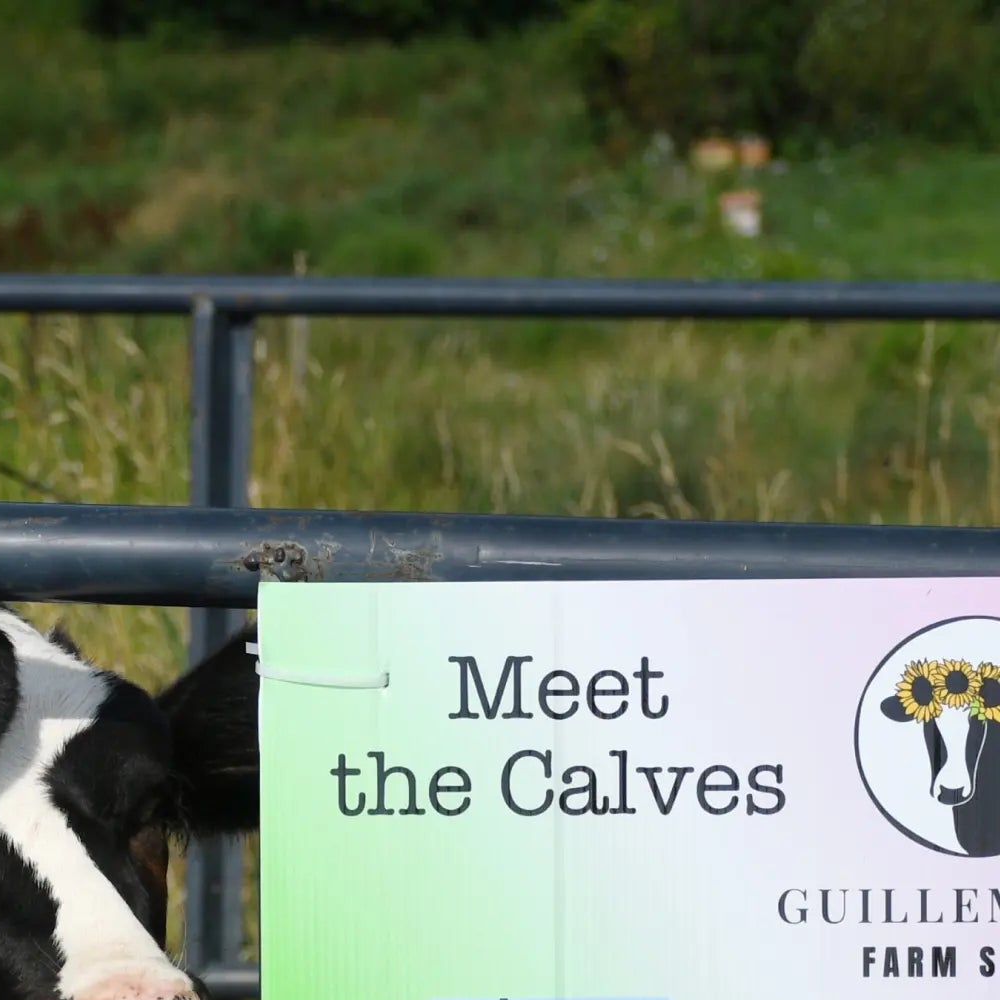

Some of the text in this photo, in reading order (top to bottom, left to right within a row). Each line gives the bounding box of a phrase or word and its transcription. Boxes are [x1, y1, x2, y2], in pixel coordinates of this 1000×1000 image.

[448, 655, 669, 720] Meet
[330, 749, 786, 817] the Calves
[862, 946, 957, 978] FARM
